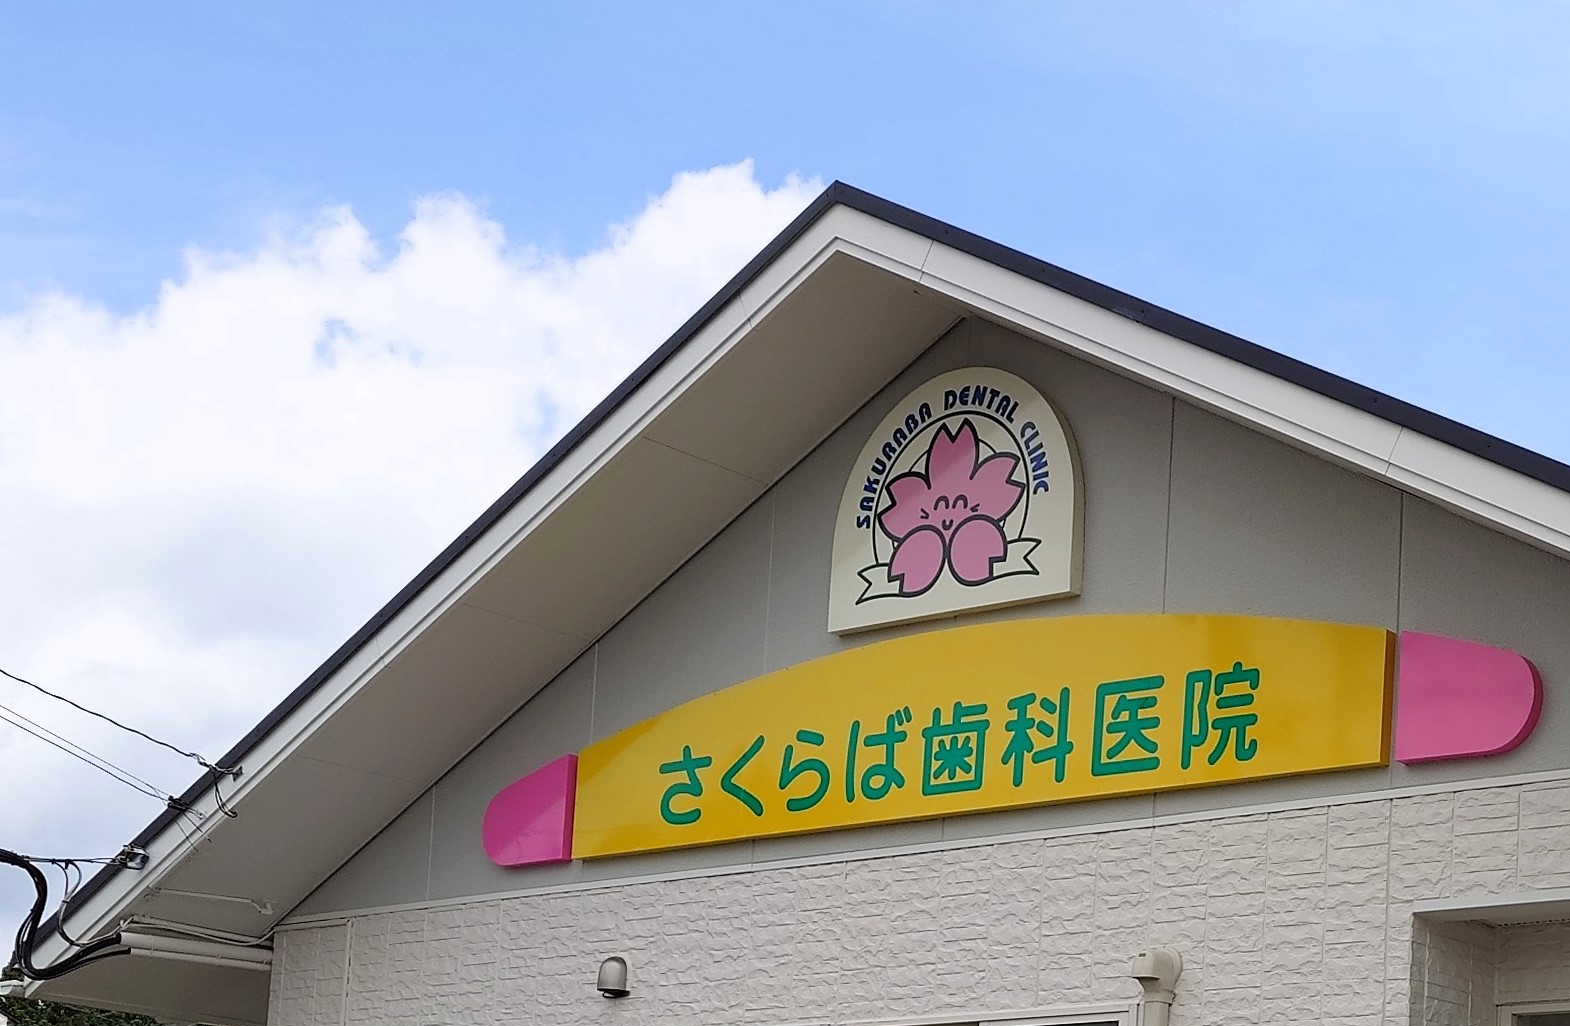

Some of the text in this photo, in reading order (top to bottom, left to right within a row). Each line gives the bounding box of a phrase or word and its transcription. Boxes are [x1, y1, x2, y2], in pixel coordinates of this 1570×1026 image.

[856, 384, 1050, 529] SAKURABA DENTAL CLINIC
[659, 660, 1262, 826] さくらば歯科医院
